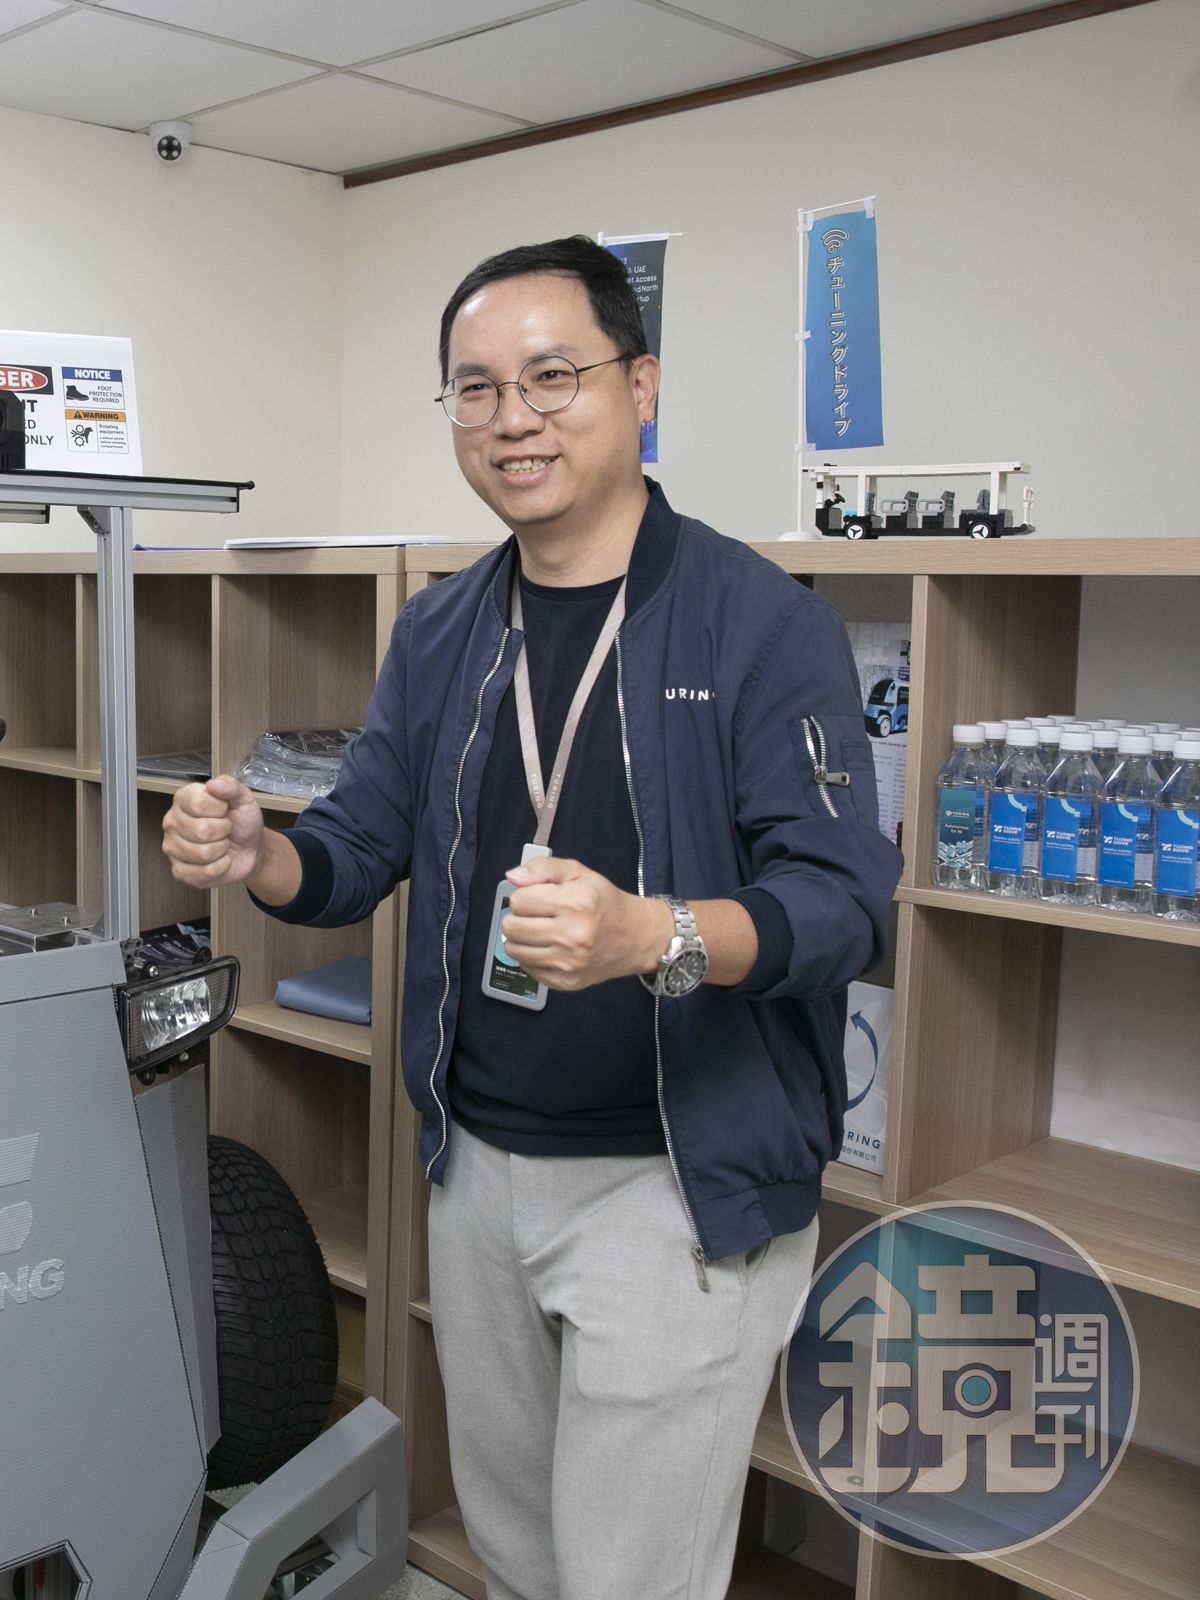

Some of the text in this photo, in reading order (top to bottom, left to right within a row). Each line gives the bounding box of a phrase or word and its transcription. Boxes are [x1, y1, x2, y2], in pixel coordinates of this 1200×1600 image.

[633, 265, 647, 274] UAE
[635, 275, 657, 283] Access
[641, 284, 659, 292] North
[74, 368, 112, 380] NOTICE
[82, 411, 119, 420] WARNING
[665, 688, 716, 701] URIN
[847, 1131, 881, 1149] RING
